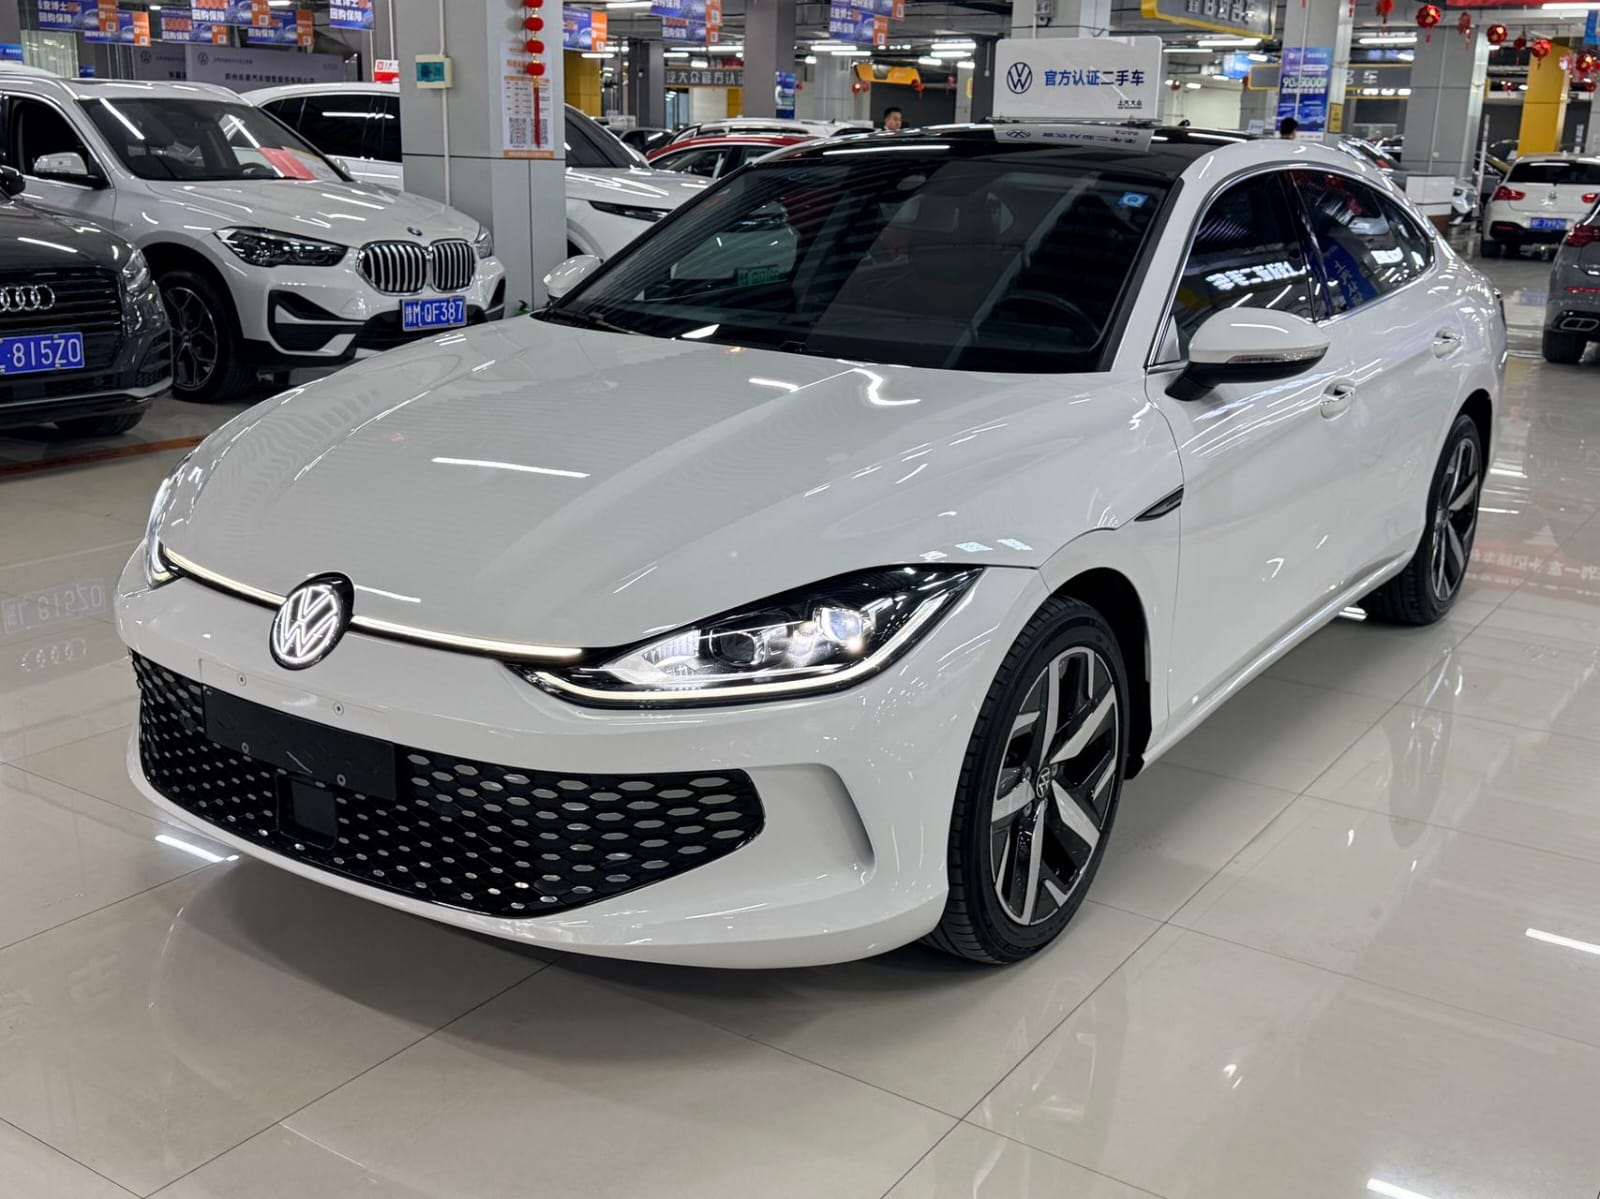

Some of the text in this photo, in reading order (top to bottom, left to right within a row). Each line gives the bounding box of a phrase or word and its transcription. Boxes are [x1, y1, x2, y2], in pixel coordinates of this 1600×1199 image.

[1044, 69, 1145, 87] 官方认证二手车
